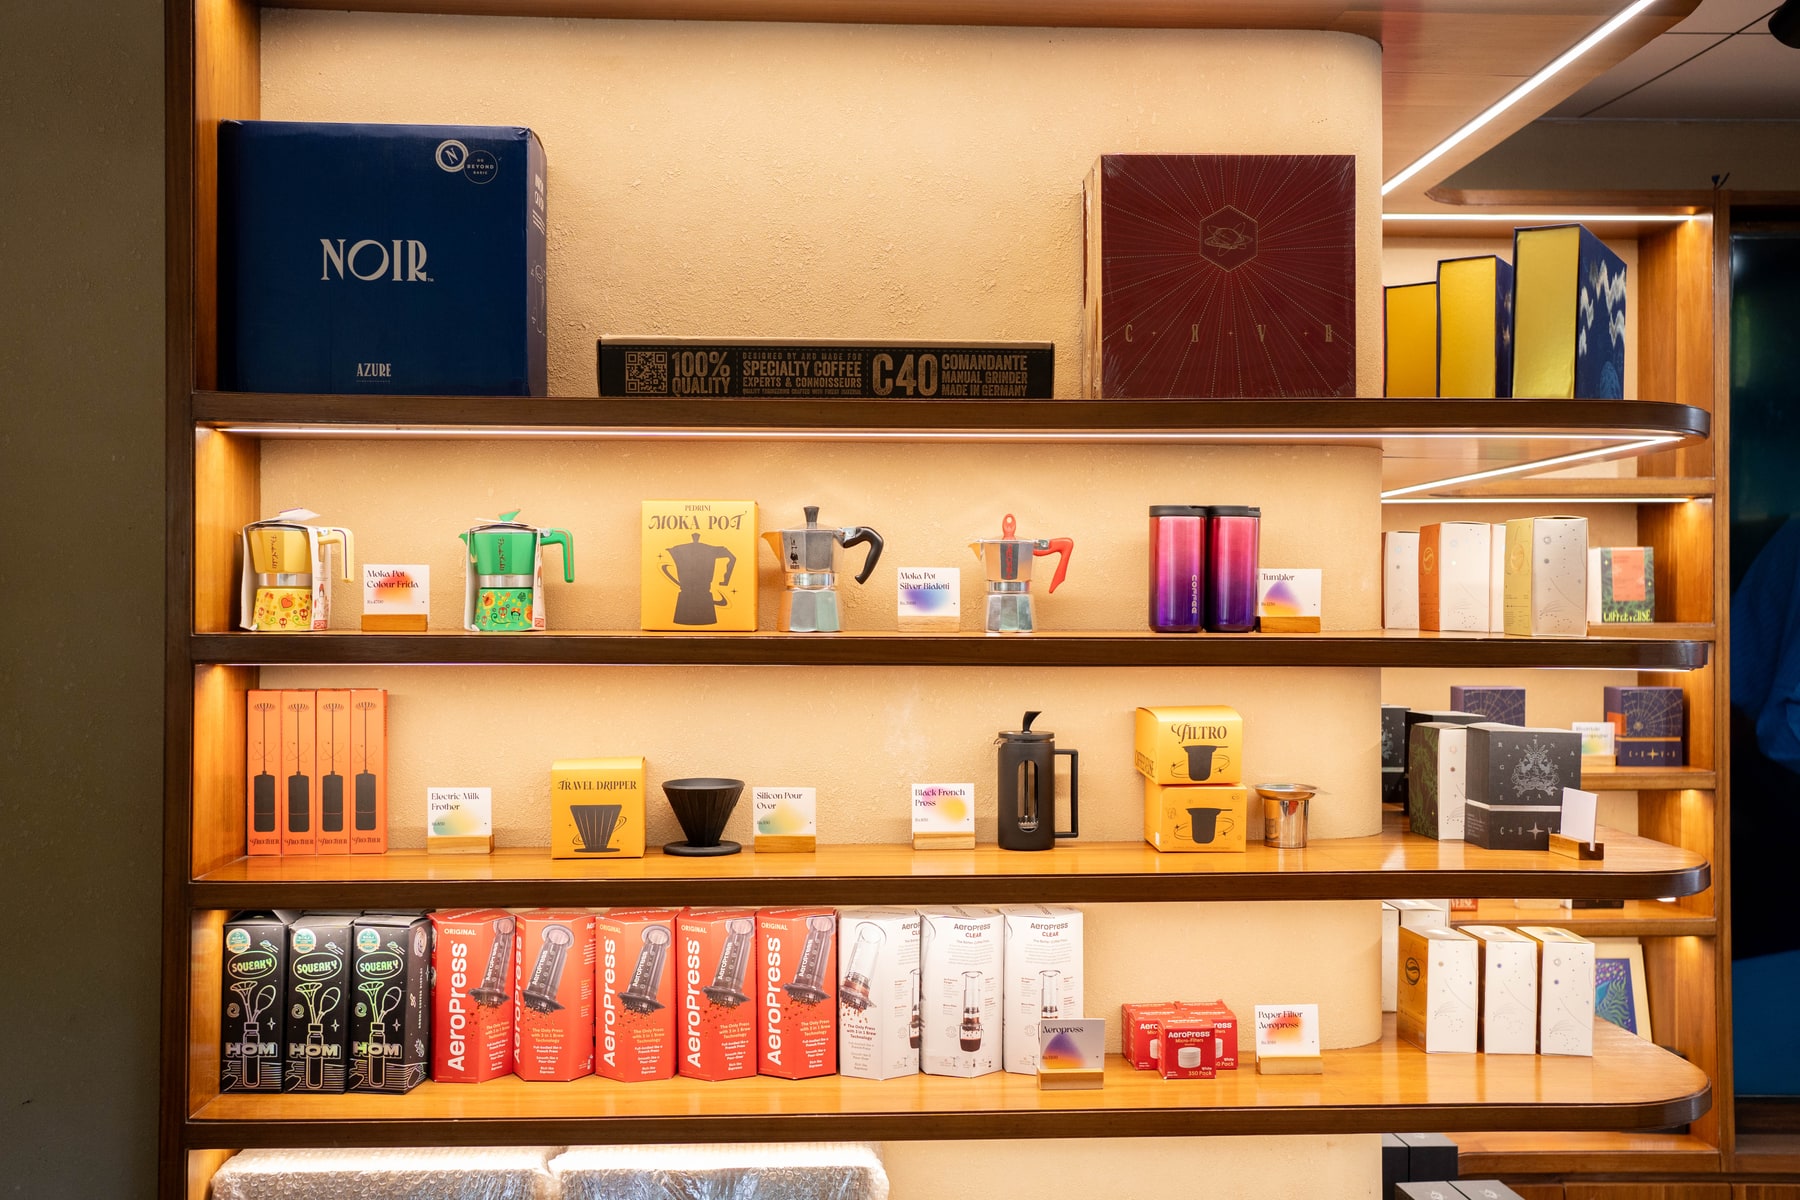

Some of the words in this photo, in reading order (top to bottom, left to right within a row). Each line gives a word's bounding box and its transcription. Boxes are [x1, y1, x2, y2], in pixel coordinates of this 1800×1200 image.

[320, 239, 428, 282] NOIR
[357, 363, 392, 376] AZURE
[672, 352, 730, 376] 100%
[743, 360, 810, 376] SPECIALTY
[814, 361, 862, 377] COFFEE
[942, 354, 1028, 370] COMANDANTE
[743, 377, 781, 387] EXPERTS
[785, 378, 792, 387] &
[796, 377, 862, 388] CONNOISSEURS
[872, 353, 938, 396] C40
[942, 370, 982, 383] MANUAL
[985, 371, 1028, 384] GRINDER
[672, 377, 730, 397] QUALITY
[942, 384, 968, 396] MADE
[970, 384, 980, 396] IN
[982, 384, 1028, 396] GERMANY
[648, 515, 700, 530] MOKA
[708, 510, 747, 530] POT
[1171, 724, 1227, 744] FILTRO
[558, 778, 594, 790] TRAVEL
[596, 781, 636, 790] DRIPPER
[600, 924, 621, 934] ORIGINAL
[681, 925, 708, 934] ORIGINAL
[761, 922, 788, 930] ORIGINAL
[902, 921, 920, 930] AeroP
[232, 958, 272, 972] SQUEAKY
[297, 960, 338, 973] SQUEAKY
[360, 960, 399, 972] SQUEAKY
[486, 942, 499, 981] AeroPress
[718, 942, 732, 980] AeroPress
[799, 939, 812, 977] AeroPress
[532, 950, 548, 986] AeroPress
[632, 951, 647, 986] AeroPress
[448, 941, 468, 1072] AeroPress
[514, 935, 522, 1064] AeroPress
[604, 936, 615, 1067] AeroPress
[686, 938, 700, 1068] AeroPress
[766, 936, 781, 1065] AeroPress
[1259, 1011, 1281, 1020] Paper
[1042, 1026, 1084, 1034] Aeropress
[1259, 1022, 1299, 1030] Aeropress
